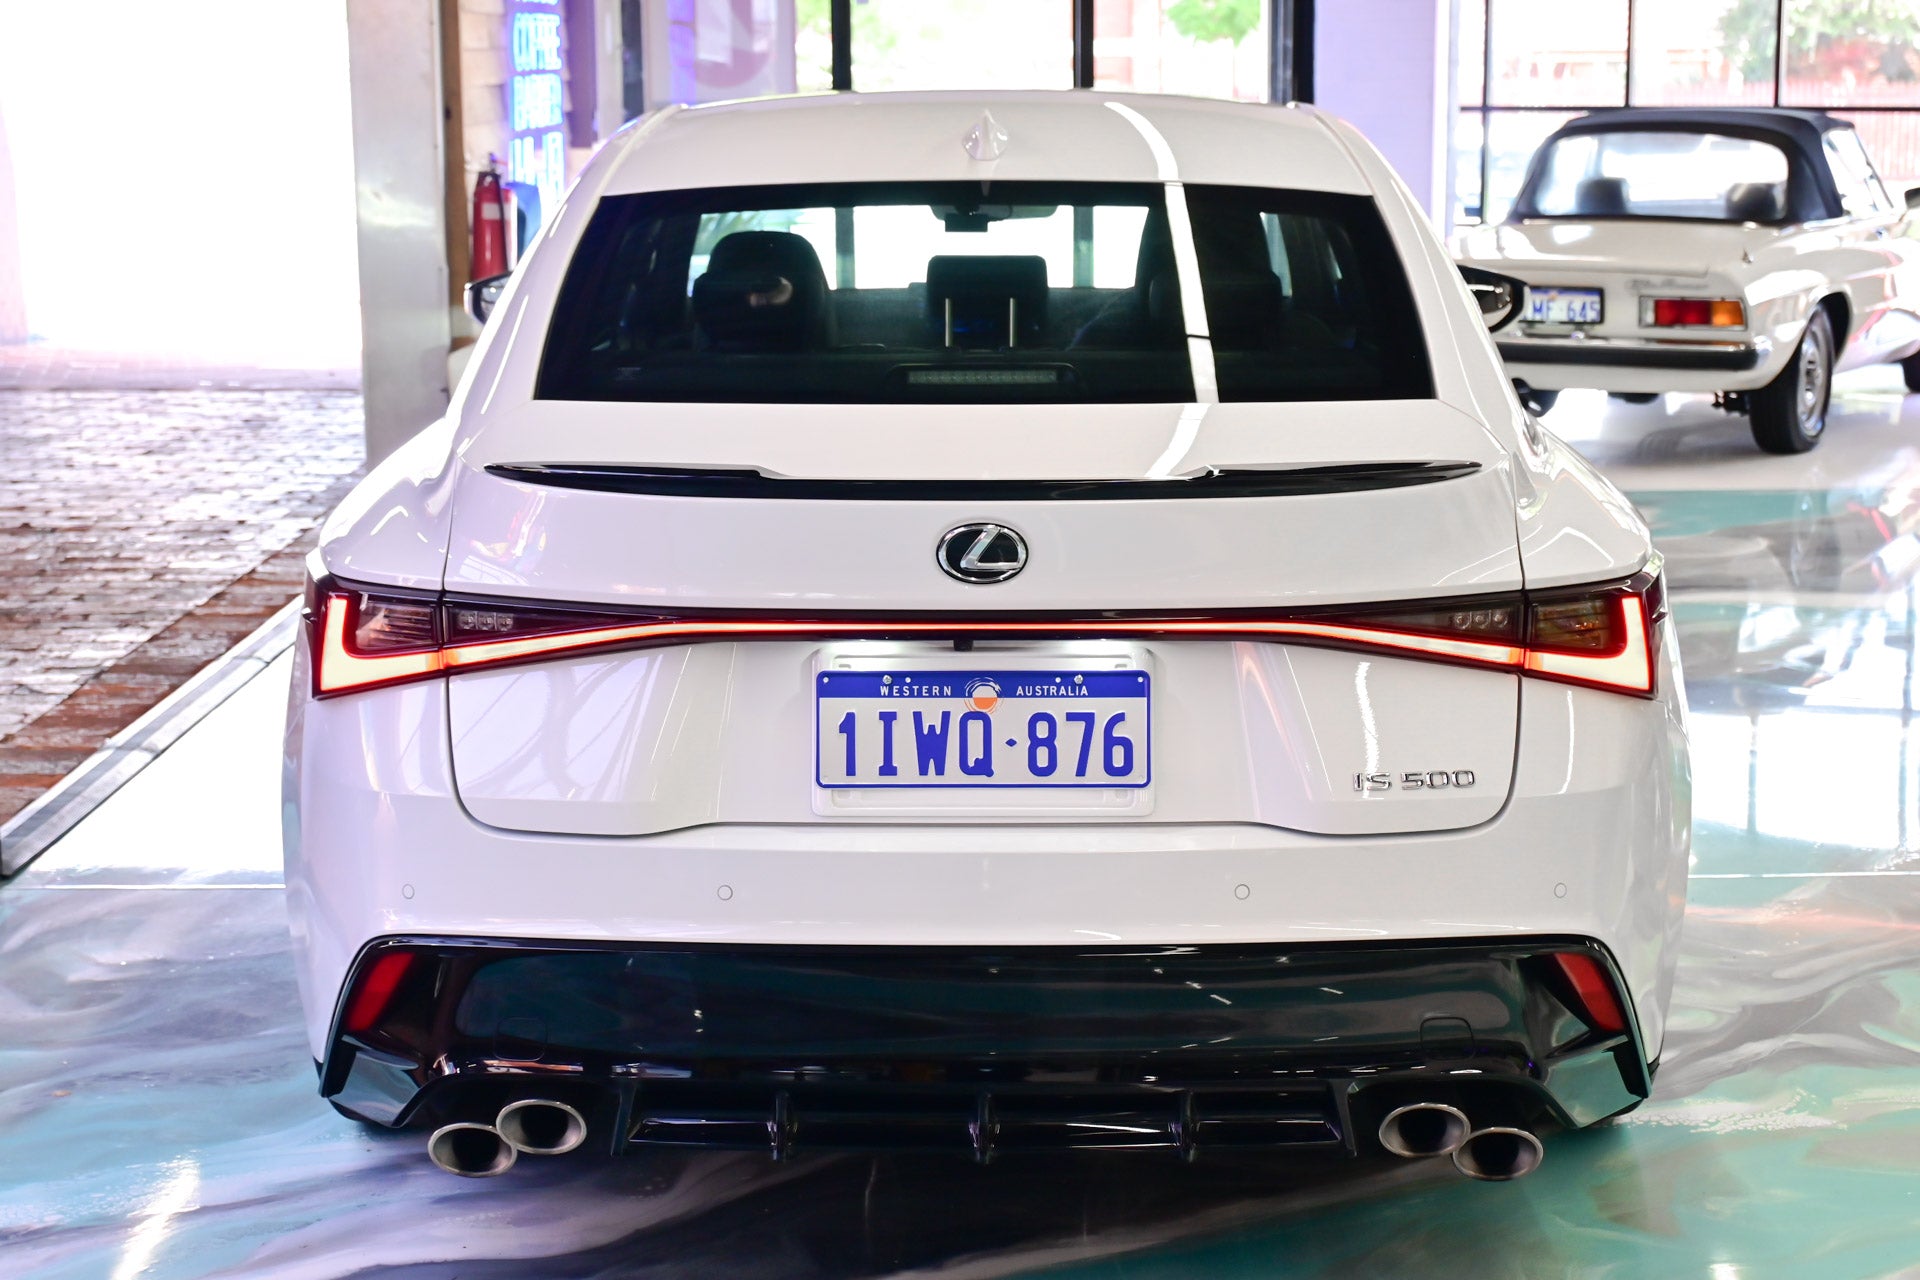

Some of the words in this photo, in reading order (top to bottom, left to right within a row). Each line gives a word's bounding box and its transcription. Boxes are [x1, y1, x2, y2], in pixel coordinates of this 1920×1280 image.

[880, 685, 952, 697] WESTERN
[1016, 685, 1089, 697] AUSTRALIA
[1353, 771, 1392, 792] IS
[1400, 770, 1475, 791] 500
